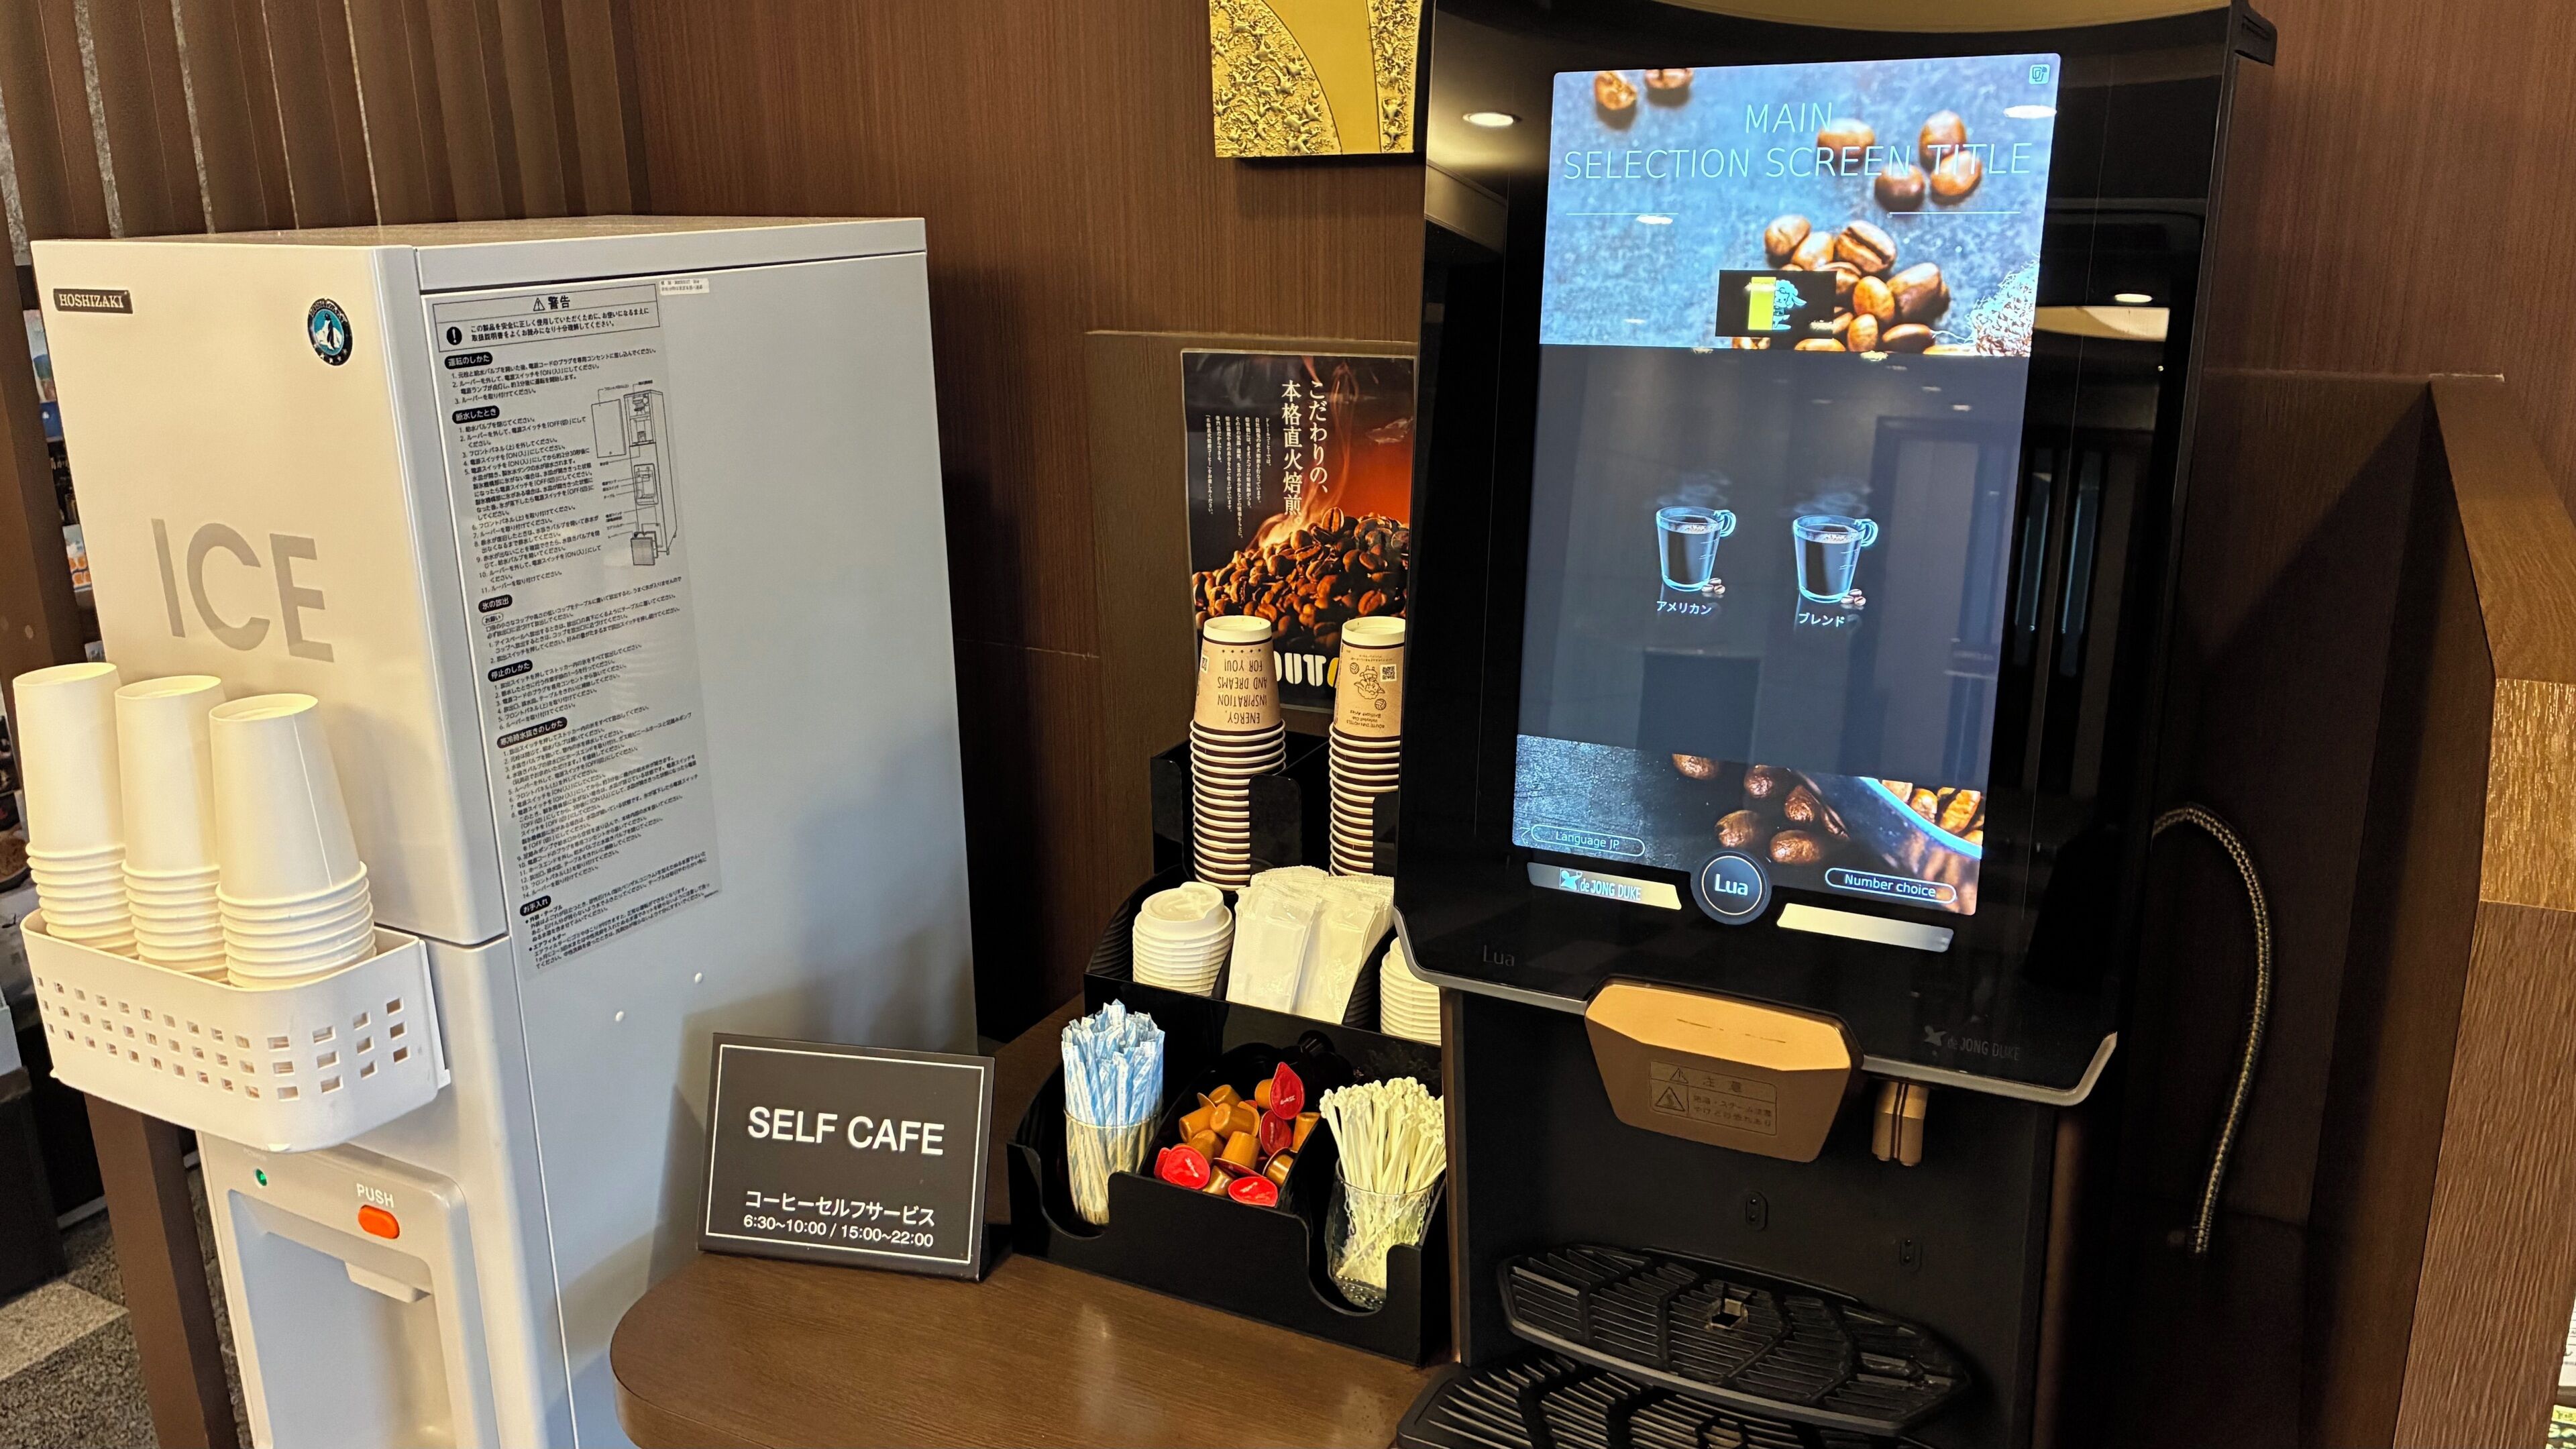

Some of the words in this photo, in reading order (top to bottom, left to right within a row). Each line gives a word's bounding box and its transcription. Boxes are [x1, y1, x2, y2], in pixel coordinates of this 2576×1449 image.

[1746, 103, 1833, 133] MAIN
[1564, 148, 1750, 180] SELECTION
[1766, 146, 1911, 177] SCREEN
[1927, 142, 2032, 174] TITLE
[58, 293, 124, 309] HOSHIZAKI
[547, 294, 571, 311] 警告
[447, 354, 490, 367] 運転のしかた
[455, 408, 496, 421] 断水したとき
[1309, 380, 1328, 493] こだわりの、
[1281, 379, 1303, 525] 本格直火焙煎。
[151, 517, 335, 663] ICE
[482, 597, 509, 610] 氷の放出
[1656, 600, 1711, 615] アメリカン
[1799, 612, 1845, 627] ブレンド
[491, 662, 530, 680] 停止のしかた
[1224, 659, 1244, 672] YOU!
[1249, 660, 1262, 672] FOR
[1218, 676, 1248, 690] DREAMS
[1253, 677, 1267, 690] AND
[1218, 694, 1267, 707] INSPIRATION
[1556, 831, 1606, 847] Language
[1609, 839, 1619, 850] JP
[1580, 878, 1590, 892] de
[1591, 880, 1615, 896] JONG
[1617, 884, 1642, 900] DUKE
[1715, 873, 1748, 896] Lua
[1845, 873, 1893, 891] Number
[1896, 879, 1937, 897] choice
[1483, 945, 1515, 966] Lua
[1960, 1037, 1988, 1055] JONG
[747, 1106, 838, 1143] SELF
[847, 1115, 945, 1156] CAFE
[356, 1183, 394, 1208] PUSH
[745, 1191, 935, 1227] コーヒーセルフサービス
[743, 1214, 826, 1236] 6:30~10:00
[830, 1223, 838, 1238] /
[841, 1224, 934, 1248] 15:00~22:00
